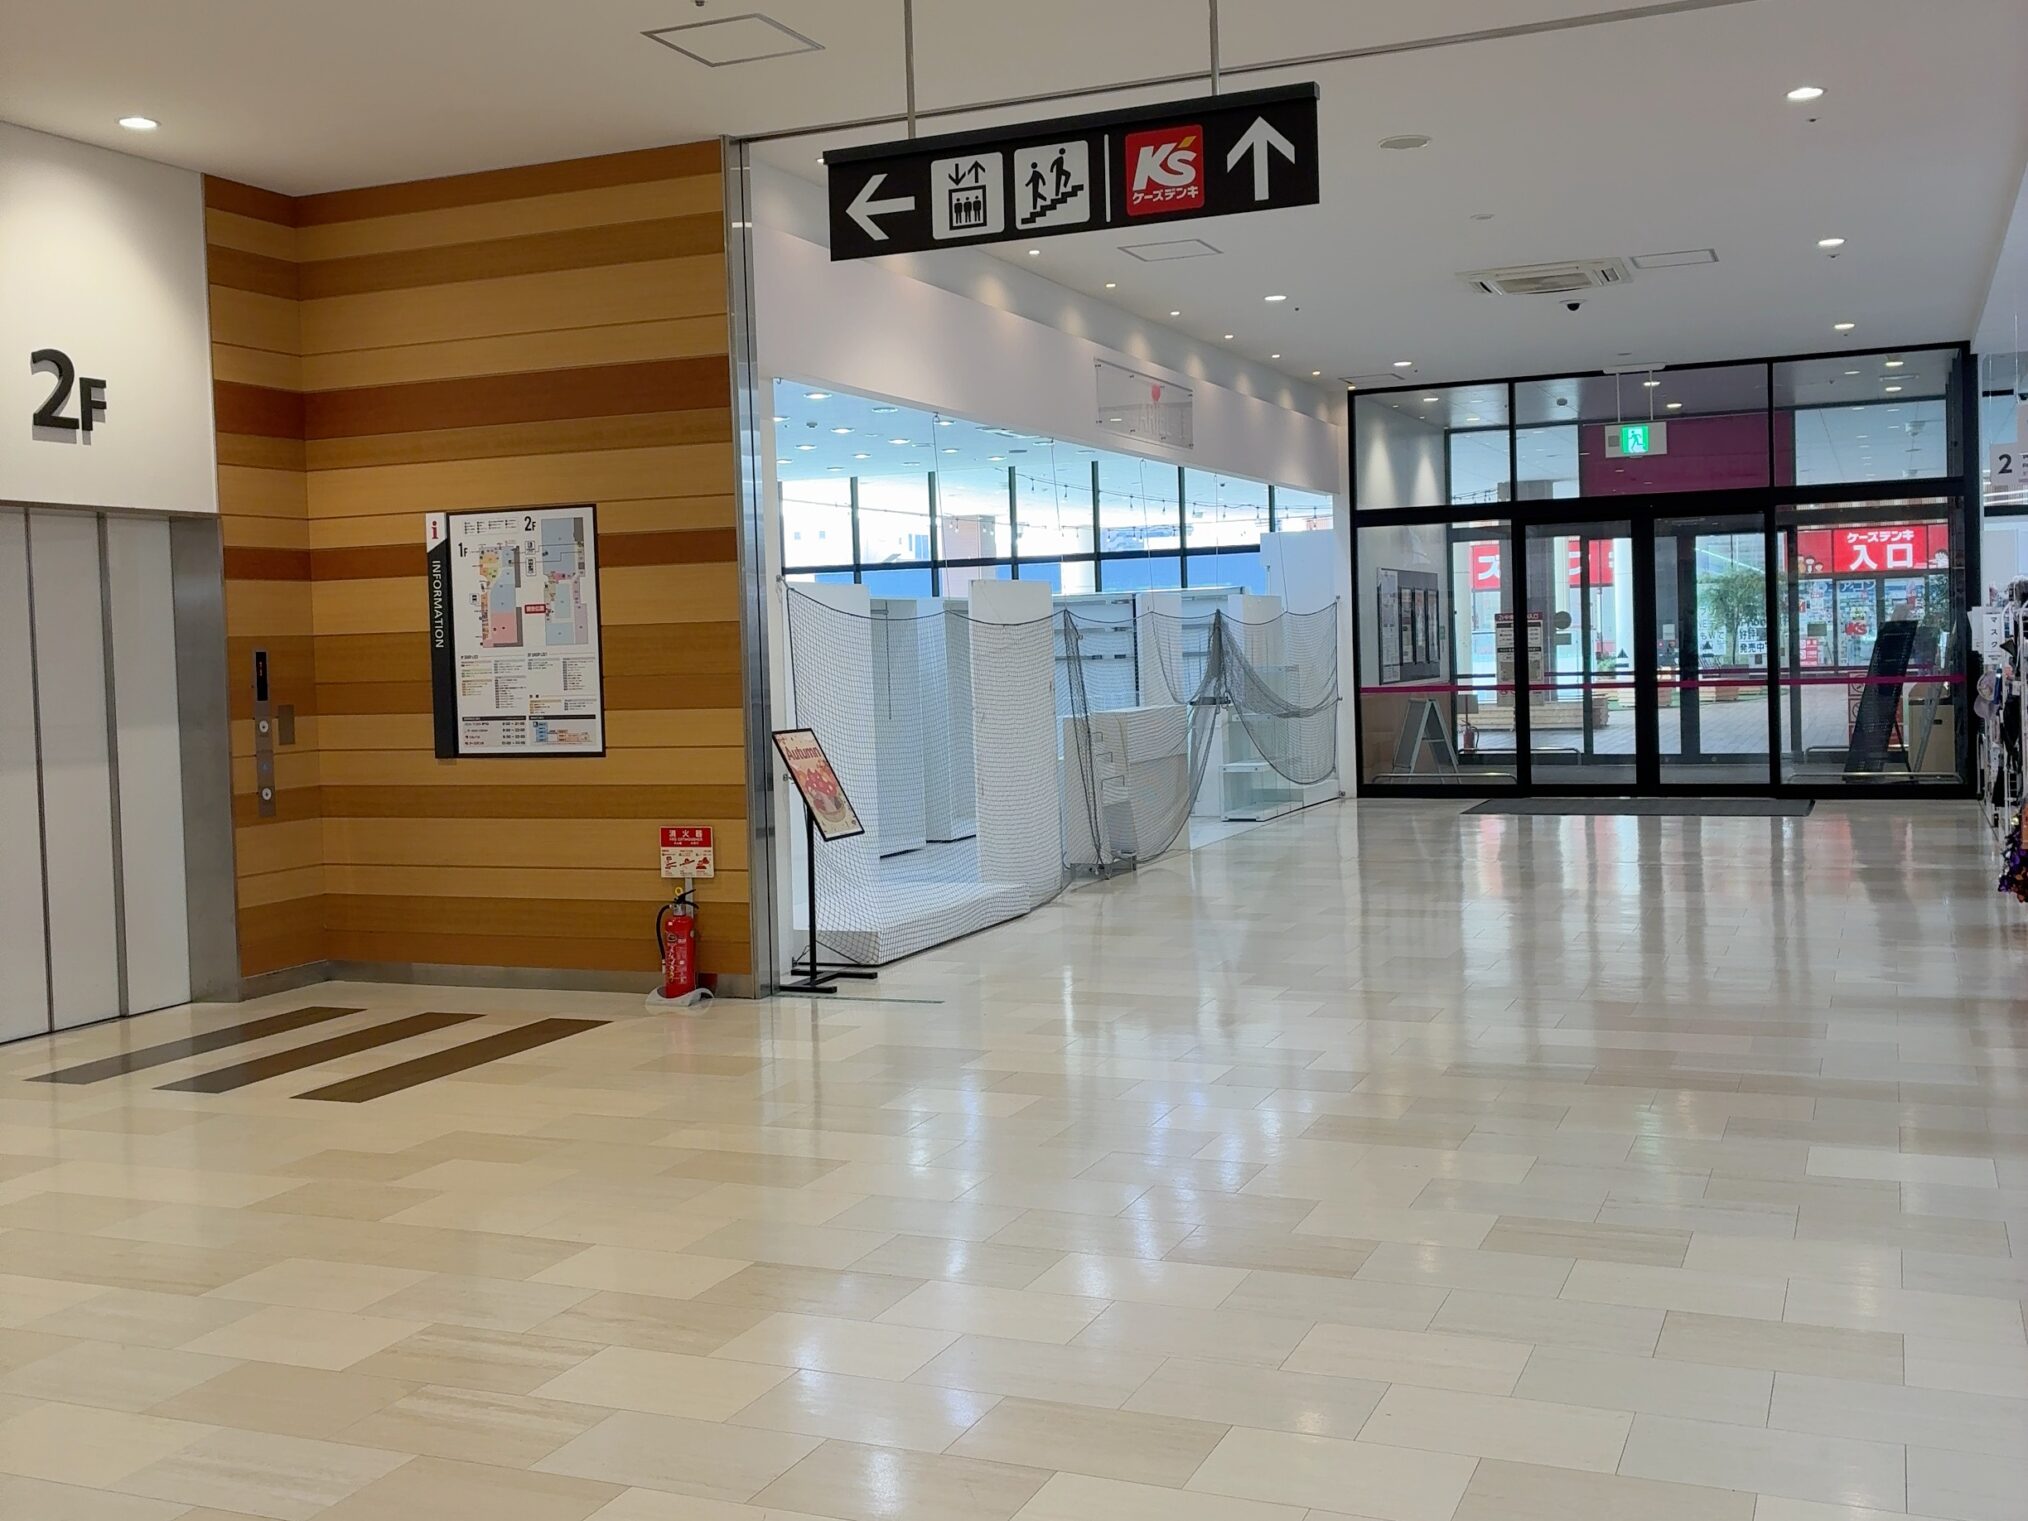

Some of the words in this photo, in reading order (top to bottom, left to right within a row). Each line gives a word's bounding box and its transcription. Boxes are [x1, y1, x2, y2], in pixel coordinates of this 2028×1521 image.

[1132, 136, 1197, 191] K's
[1132, 185, 1199, 205] ケーズデンキ
[31, 349, 107, 432] 2F
[1998, 454, 2013, 474] 2
[524, 516, 536, 531] 2F
[1847, 529, 1914, 544] ケーズデンキ
[458, 542, 468, 557] 1F
[1850, 543, 1914, 571] 入口
[432, 560, 444, 648] INFORMATION
[1990, 617, 1998, 648] マスク
[1740, 643, 1764, 653] 発売中
[784, 746, 822, 761] Autumn
